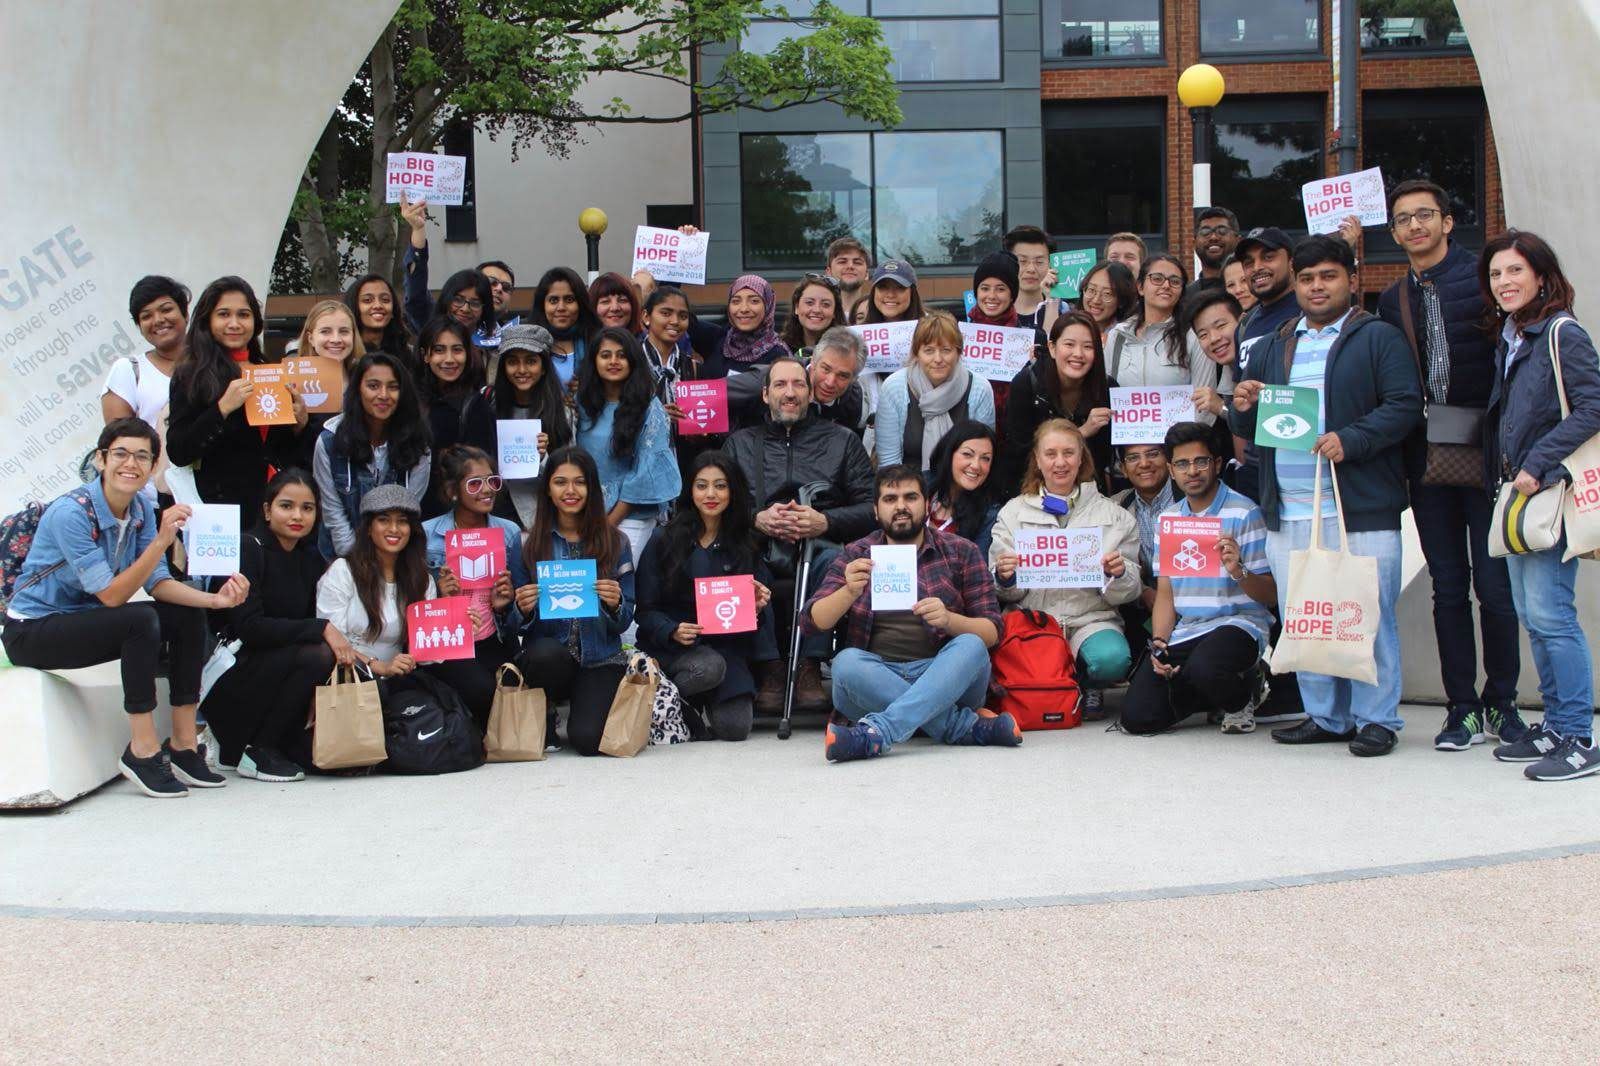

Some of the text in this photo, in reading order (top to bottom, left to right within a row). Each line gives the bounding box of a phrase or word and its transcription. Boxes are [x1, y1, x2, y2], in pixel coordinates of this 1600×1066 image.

[406, 157, 434, 172] BIG
[389, 172, 434, 187] HOPE
[1322, 181, 1352, 197] BIG
[1307, 196, 1354, 218] HOPE
[652, 233, 680, 247] BIG
[636, 246, 678, 263] HOPE
[1053, 255, 1060, 267] 3
[48, 279, 97, 317] enters
[862, 327, 889, 342] BIG
[976, 329, 1004, 345] BIG
[14, 313, 99, 377] through me
[16, 319, 137, 428] will be saved
[244, 369, 251, 381] 7
[288, 361, 295, 375] 2
[676, 385, 688, 398] 10
[1112, 391, 1161, 406] The BIG
[1260, 388, 1273, 404] 13
[1113, 408, 1162, 423] HOPE
[20, 434, 50, 462] will
[44, 413, 82, 445] come
[503, 455, 536, 464] GOALS
[1163, 520, 1171, 534] 9
[450, 532, 480, 547] 4 QUALITY
[1018, 535, 1068, 550] The BIG
[196, 546, 238, 557] GOALS
[1018, 553, 1069, 568] HOPE
[537, 564, 550, 578] 14
[1058, 575, 1079, 583] June
[1080, 574, 1101, 582] 2018
[699, 581, 707, 595] 5
[873, 583, 911, 593] GOALS
[414, 604, 420, 618] 1
[425, 609, 448, 617] POVERTY
[1286, 600, 1333, 616] The BIG
[1285, 618, 1333, 635] HOPE
[1533, 736, 1556, 754] N
[1566, 751, 1588, 770] N
